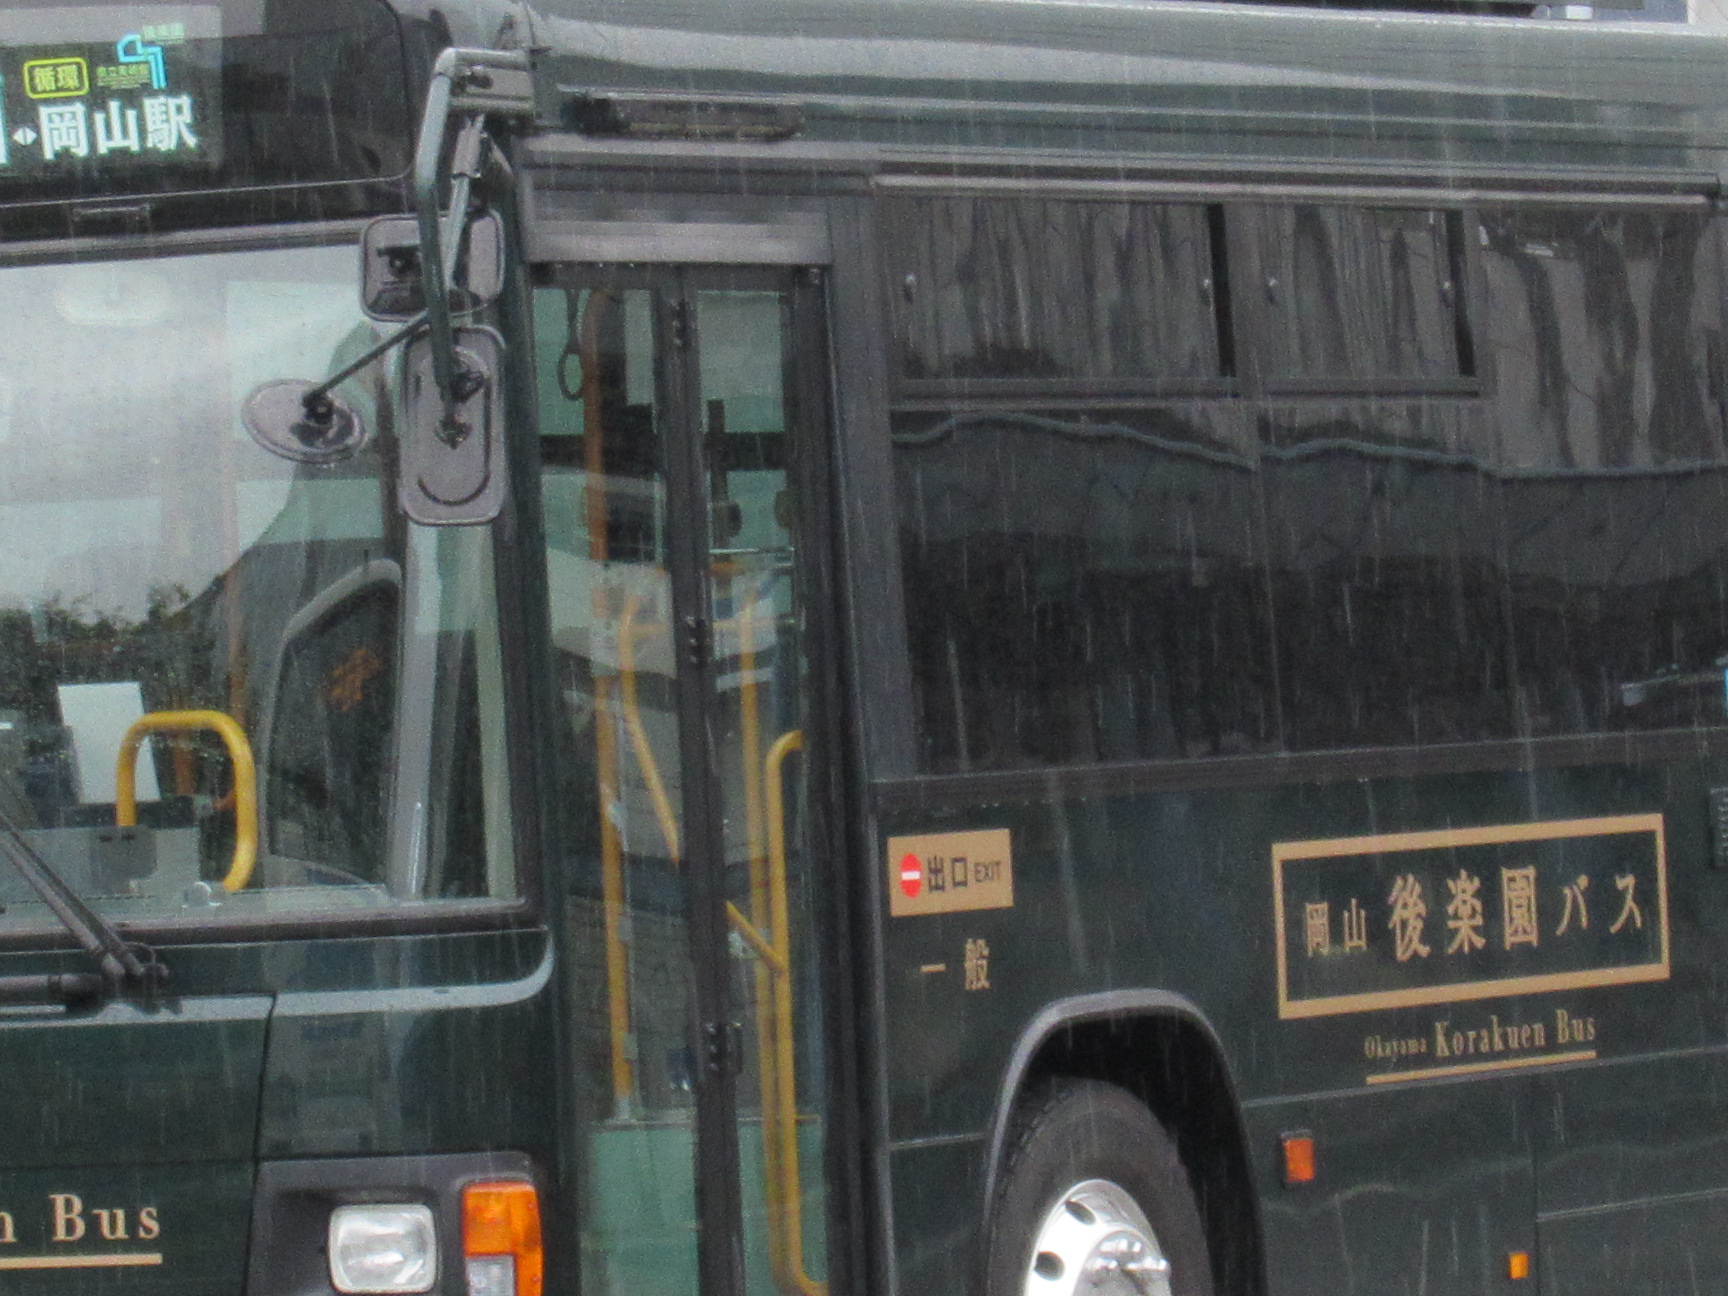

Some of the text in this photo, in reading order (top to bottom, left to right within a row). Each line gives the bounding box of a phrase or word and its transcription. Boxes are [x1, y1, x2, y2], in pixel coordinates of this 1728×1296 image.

[38, 93, 198, 160] 岡山駅
[928, 855, 1001, 892] 出口 EXIT
[1364, 1009, 1596, 1062] Okayama Korakuen Bus
[48, 1193, 161, 1242] Bus
